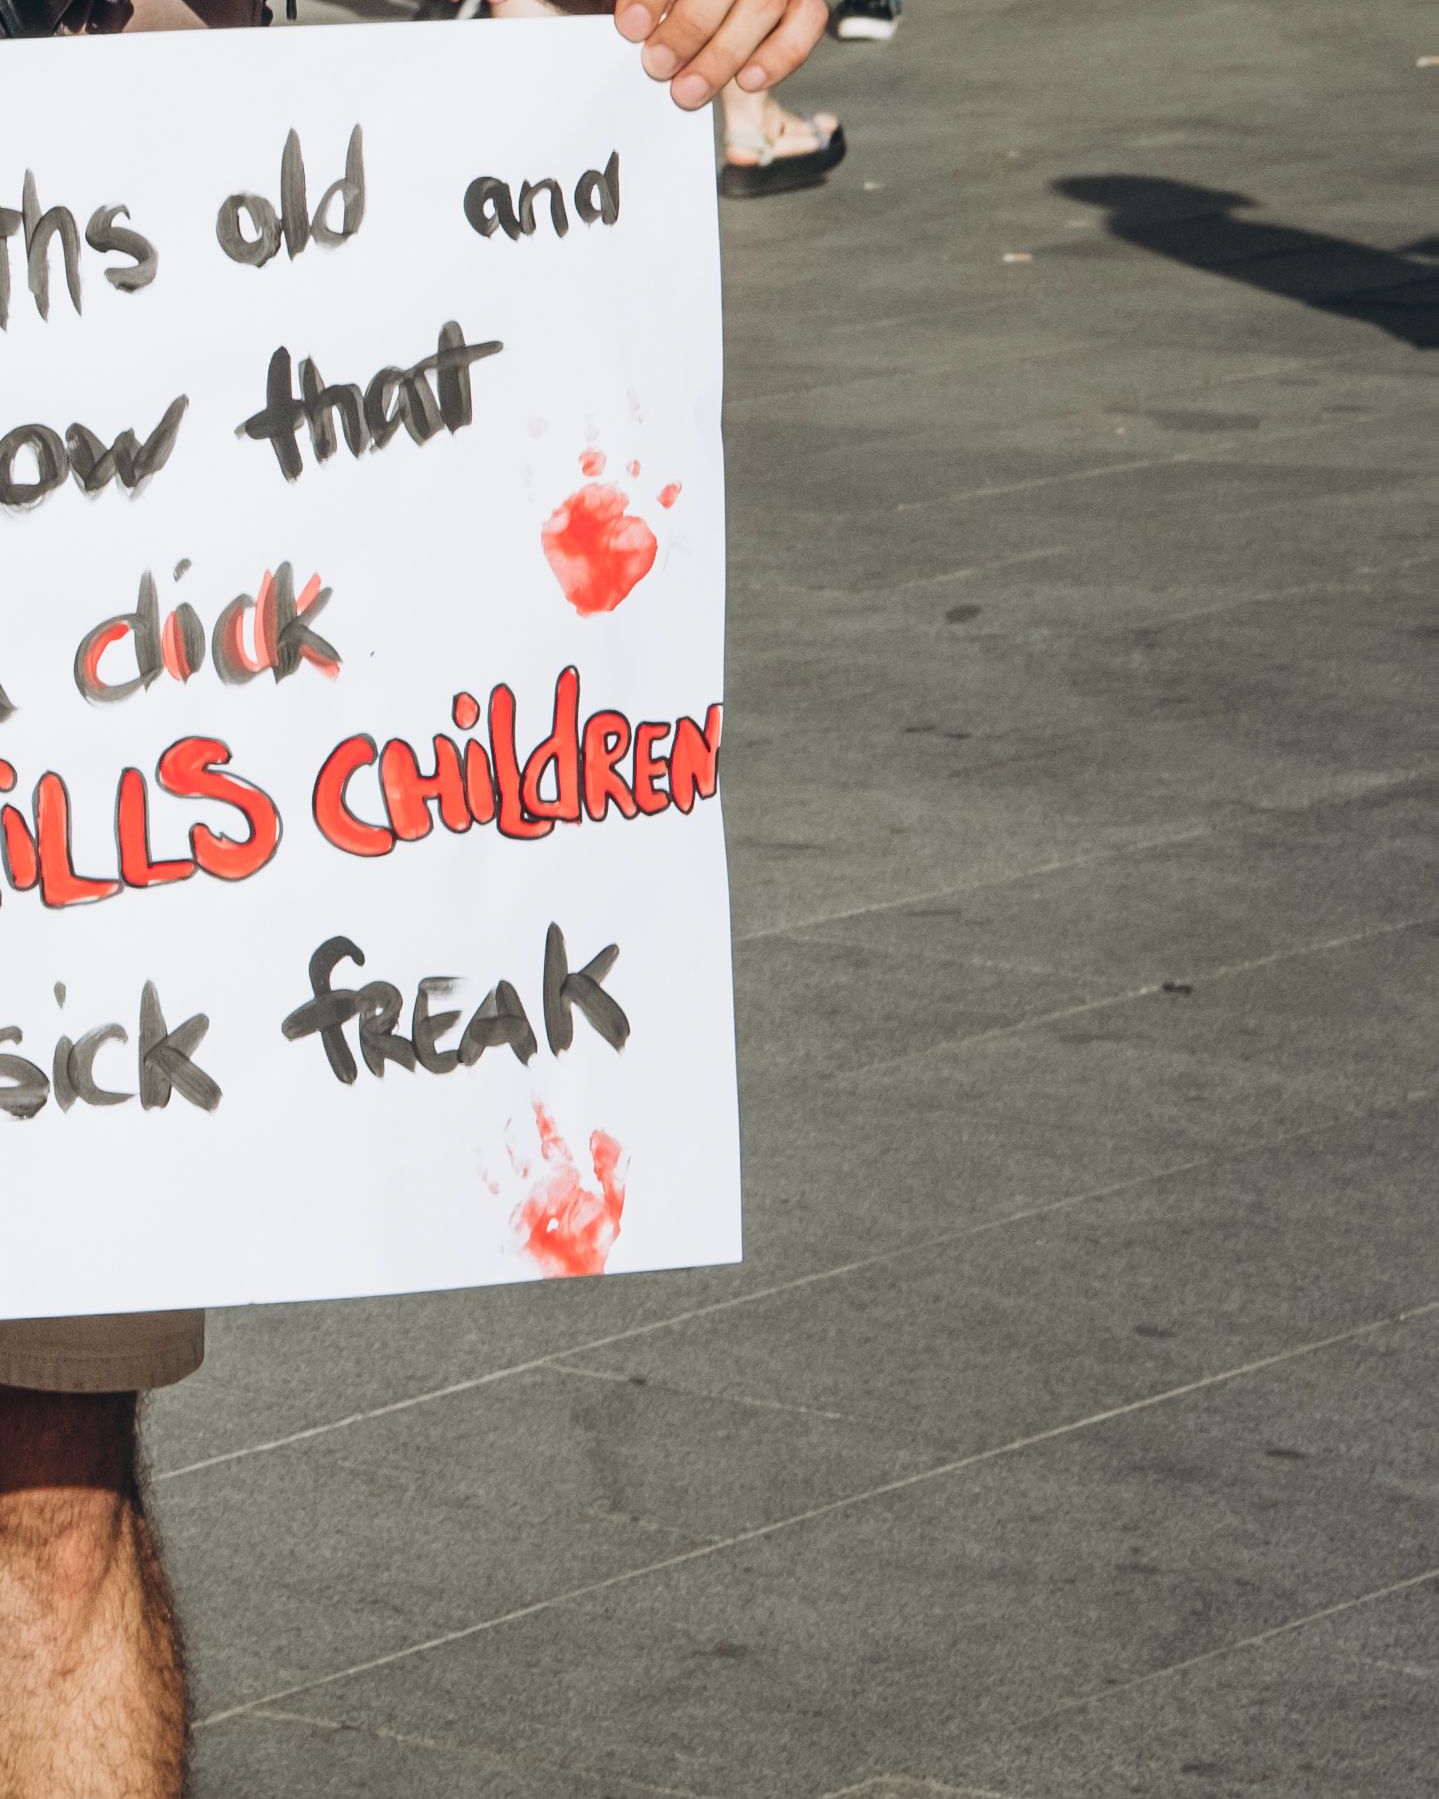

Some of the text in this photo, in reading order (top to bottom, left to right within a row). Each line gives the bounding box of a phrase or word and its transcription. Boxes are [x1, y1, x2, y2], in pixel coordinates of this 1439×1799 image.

[216, 123, 366, 267] old
[464, 150, 620, 240] and
[236, 320, 504, 483] that
[73, 558, 342, 700] dick
